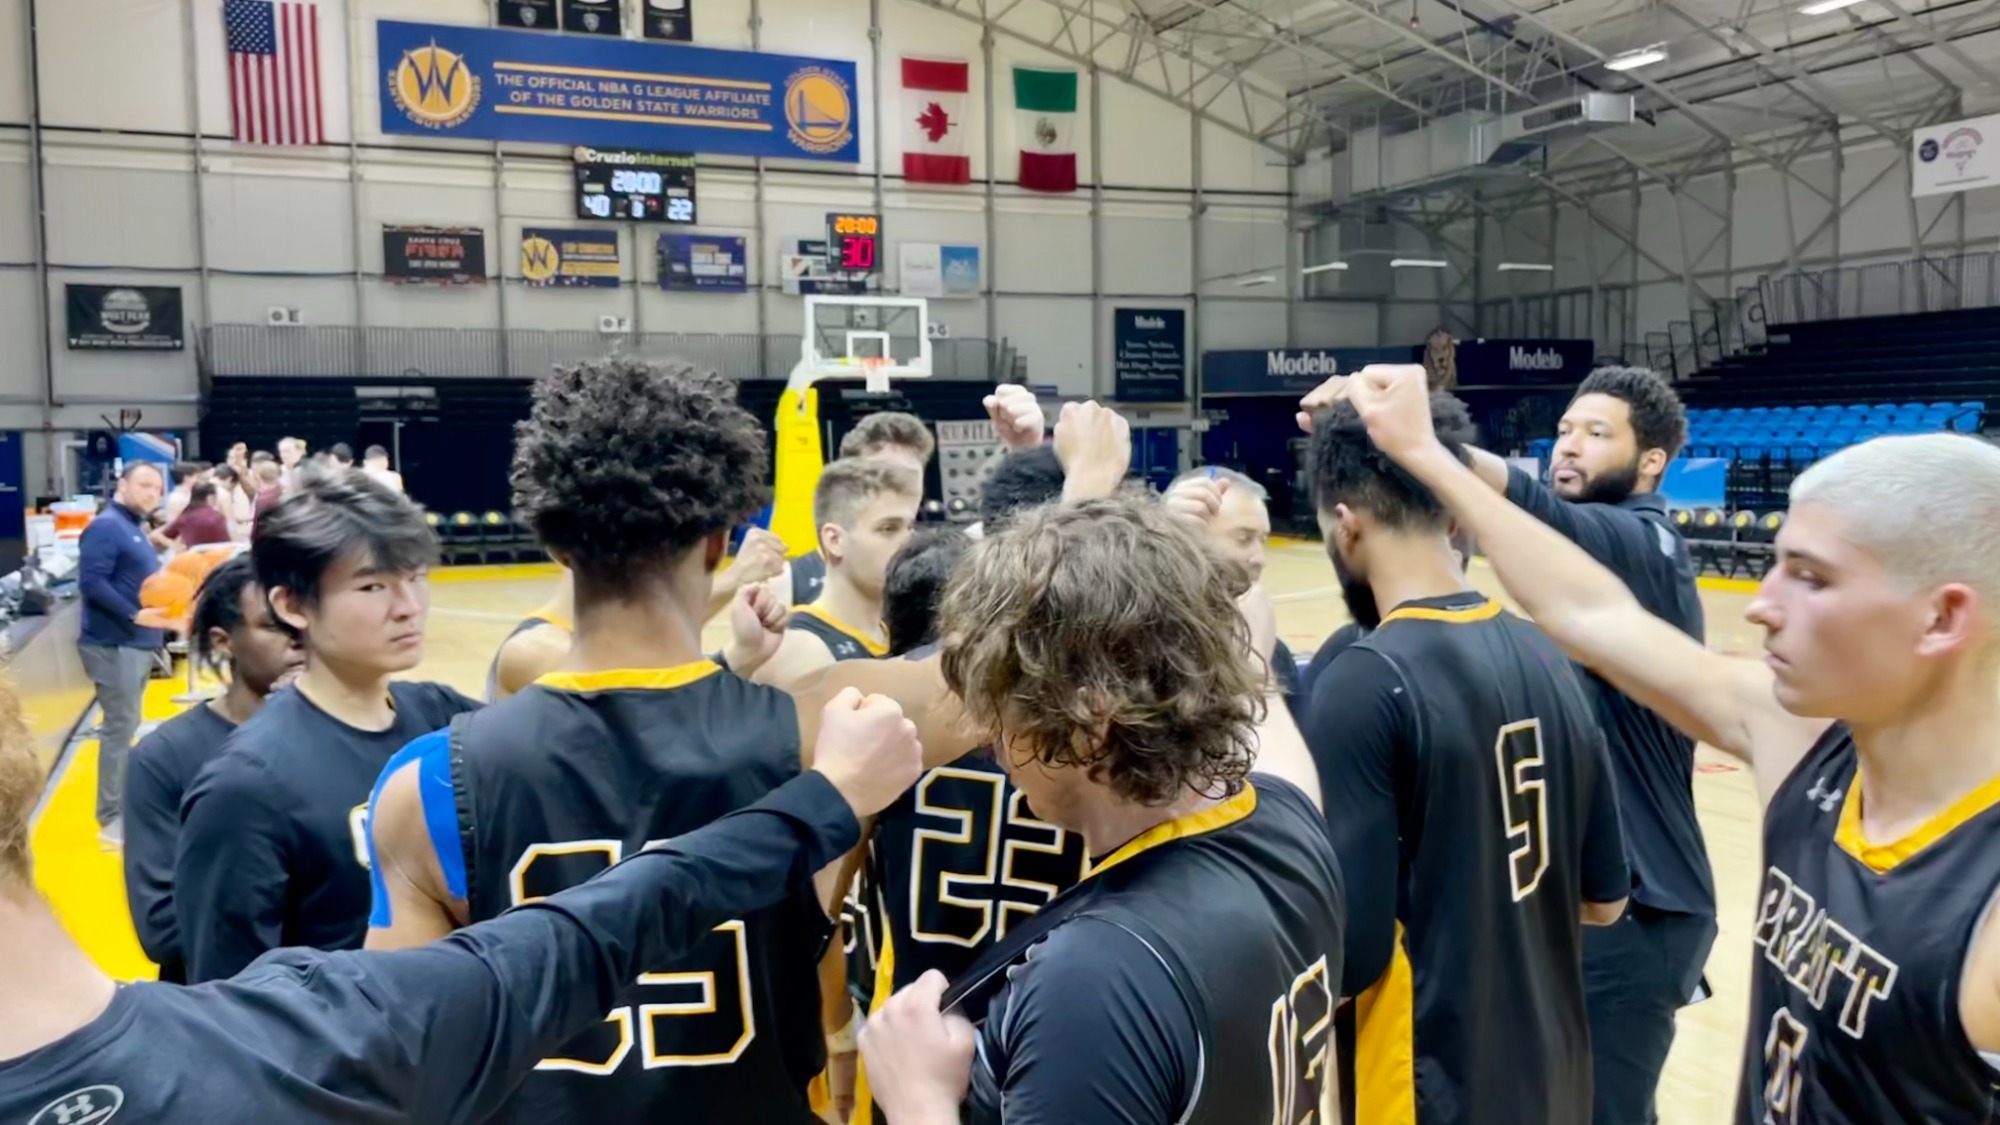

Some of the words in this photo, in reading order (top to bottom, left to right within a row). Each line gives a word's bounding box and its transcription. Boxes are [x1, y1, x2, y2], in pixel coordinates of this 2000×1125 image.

[495, 73, 524, 87] THE
[527, 76, 595, 92] OFFICIAL
[598, 81, 629, 94] NBA
[633, 84, 643, 96] G
[647, 85, 700, 100] LEAGUE
[704, 90, 771, 106] AFFILIATE
[510, 90, 531, 103] OF
[537, 92, 566, 106] THE
[570, 95, 632, 110] GOLDEN
[636, 100, 679, 114] STATE
[684, 104, 759, 120] WARRIORS
[667, 198, 693, 220] 22
[842, 237, 873, 267] 30
[1267, 350, 1337, 376] Modelo
[1509, 345, 1563, 370] Modelo
[1496, 717, 1550, 902] 5
[1754, 866, 1899, 1039] PRATT
